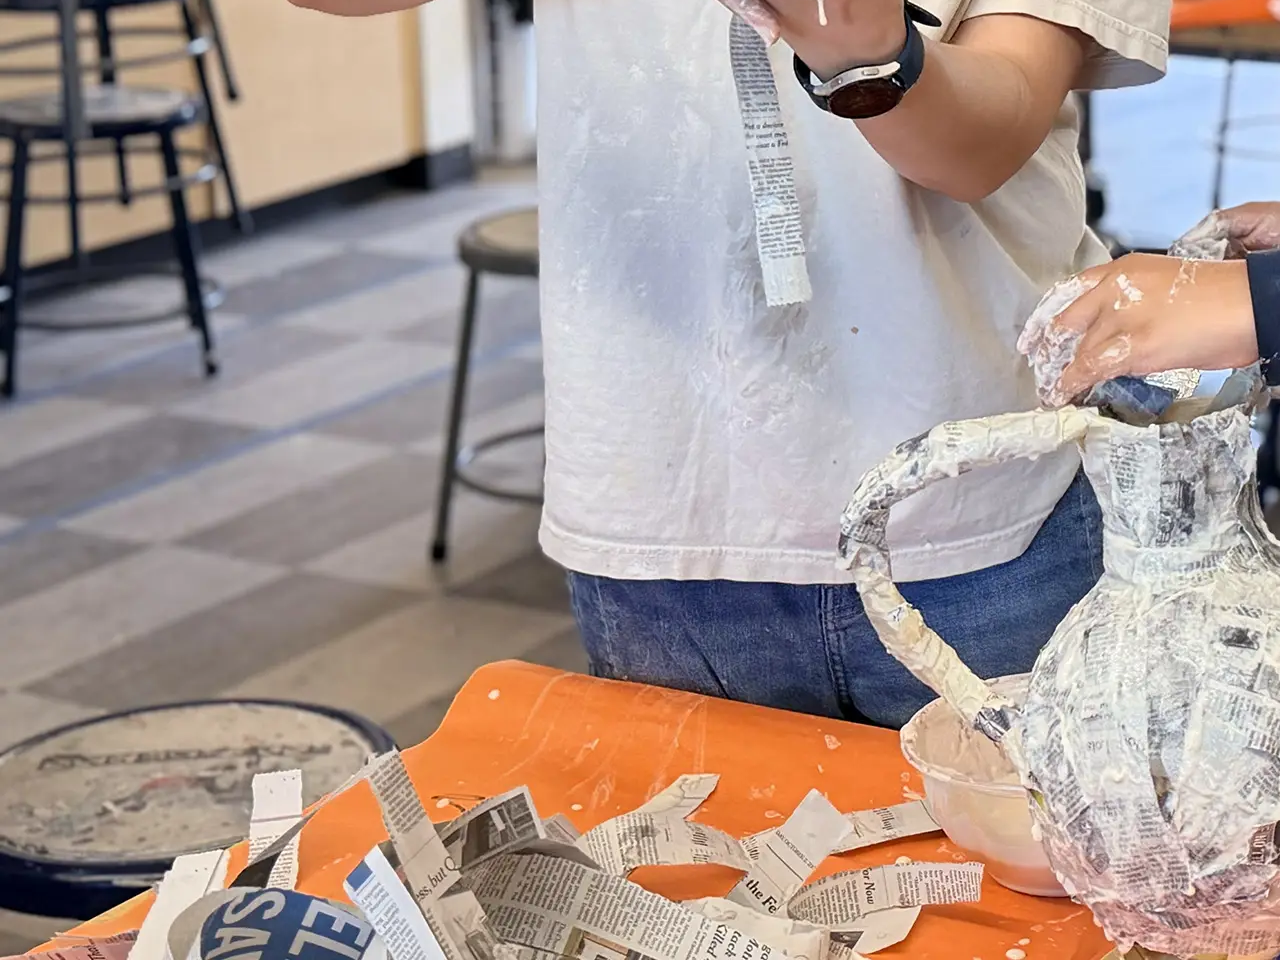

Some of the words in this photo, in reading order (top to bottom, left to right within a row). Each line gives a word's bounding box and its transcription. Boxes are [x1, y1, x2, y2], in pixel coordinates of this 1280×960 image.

[427, 866, 448, 888] but
[744, 878, 764, 900] the
[761, 895, 778, 915] Fe
[863, 881, 877, 905] Now
[724, 930, 743, 958] tack
